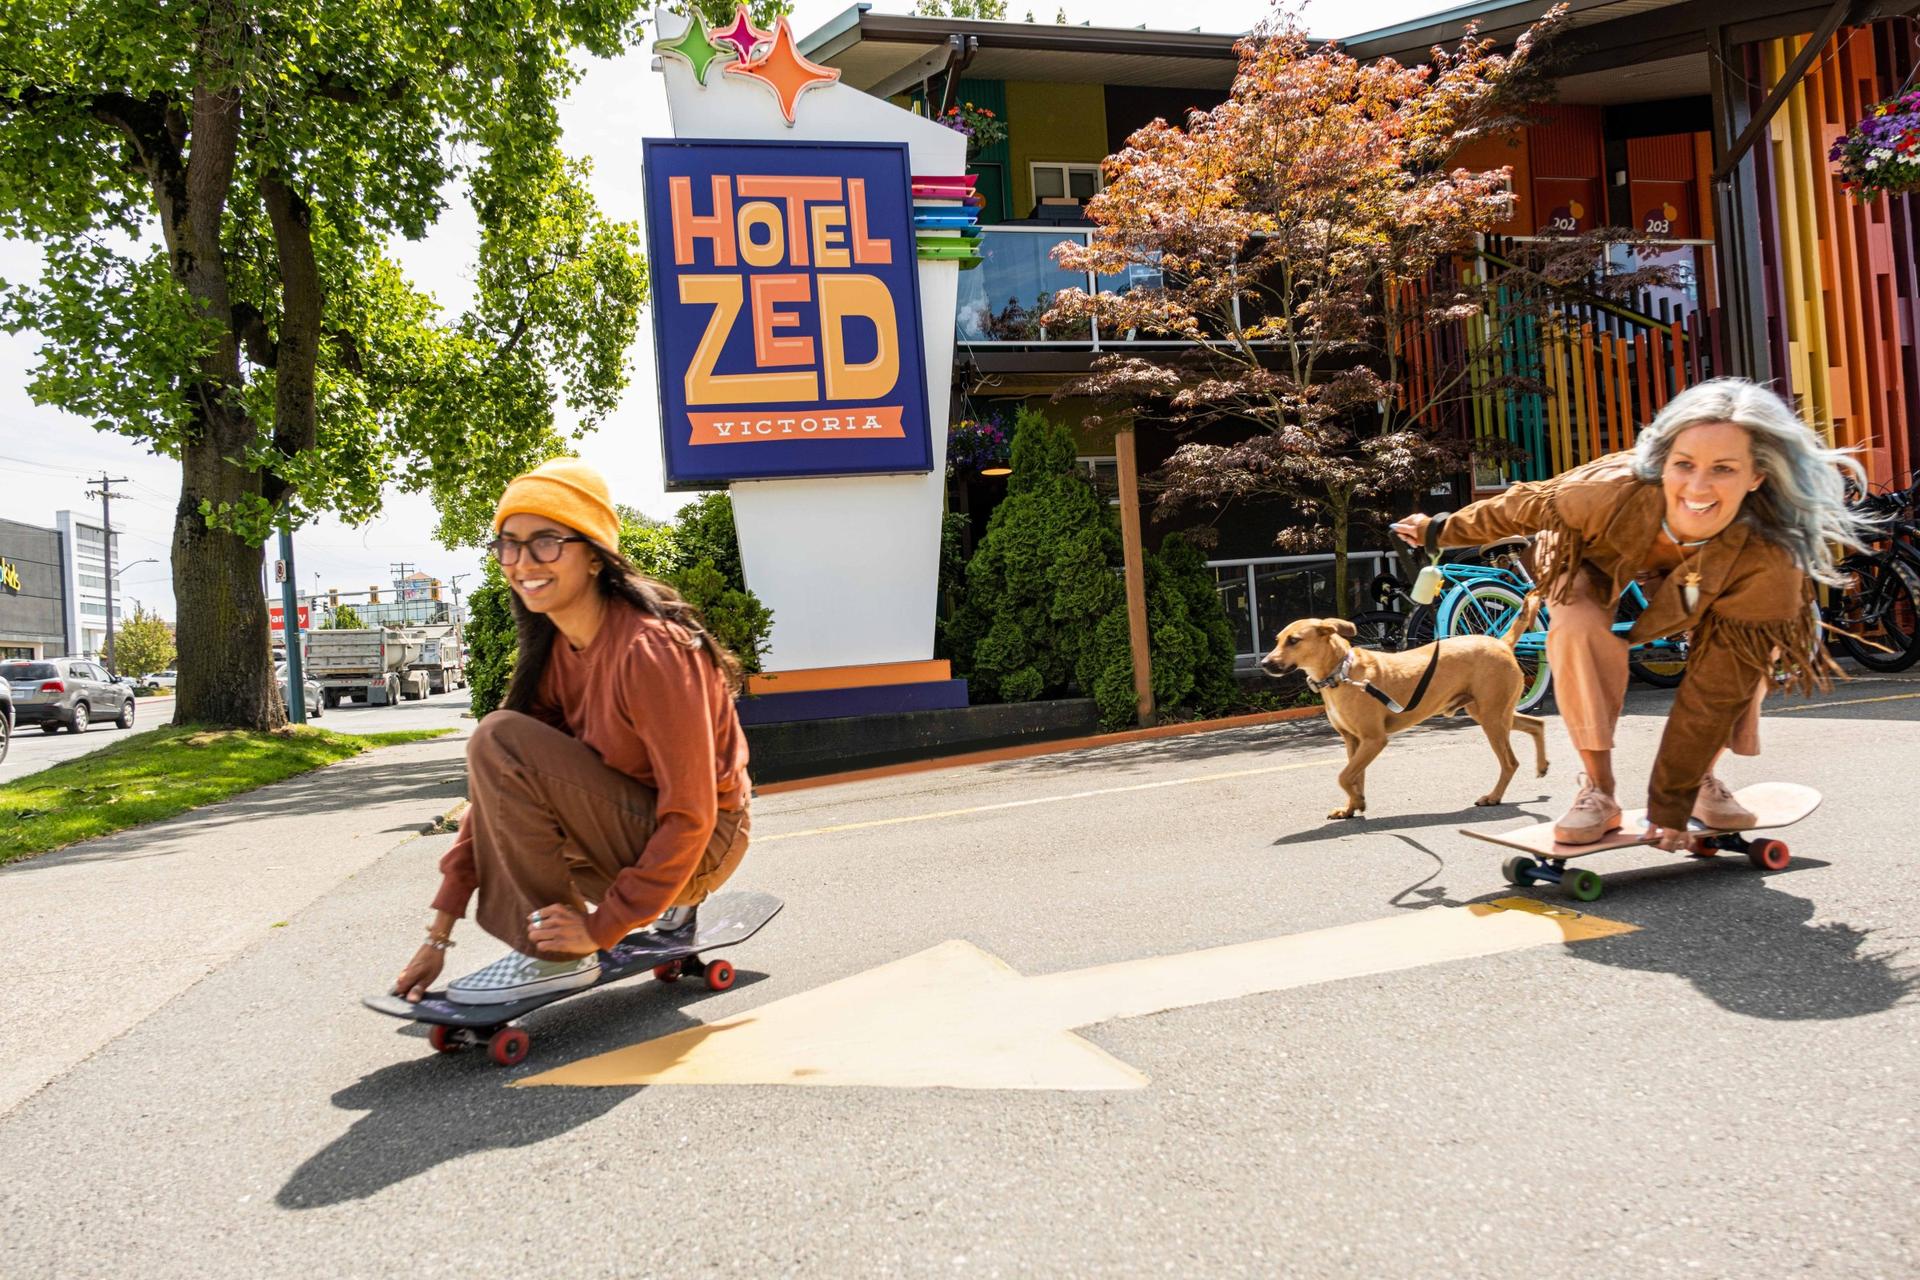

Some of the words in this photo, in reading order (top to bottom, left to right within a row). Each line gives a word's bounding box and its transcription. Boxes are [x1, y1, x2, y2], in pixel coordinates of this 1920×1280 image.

[669, 175, 892, 267] HOTEL
[1646, 219, 1669, 233] 203
[678, 273, 900, 405] ZED
[713, 415, 882, 436] VICTORIA
